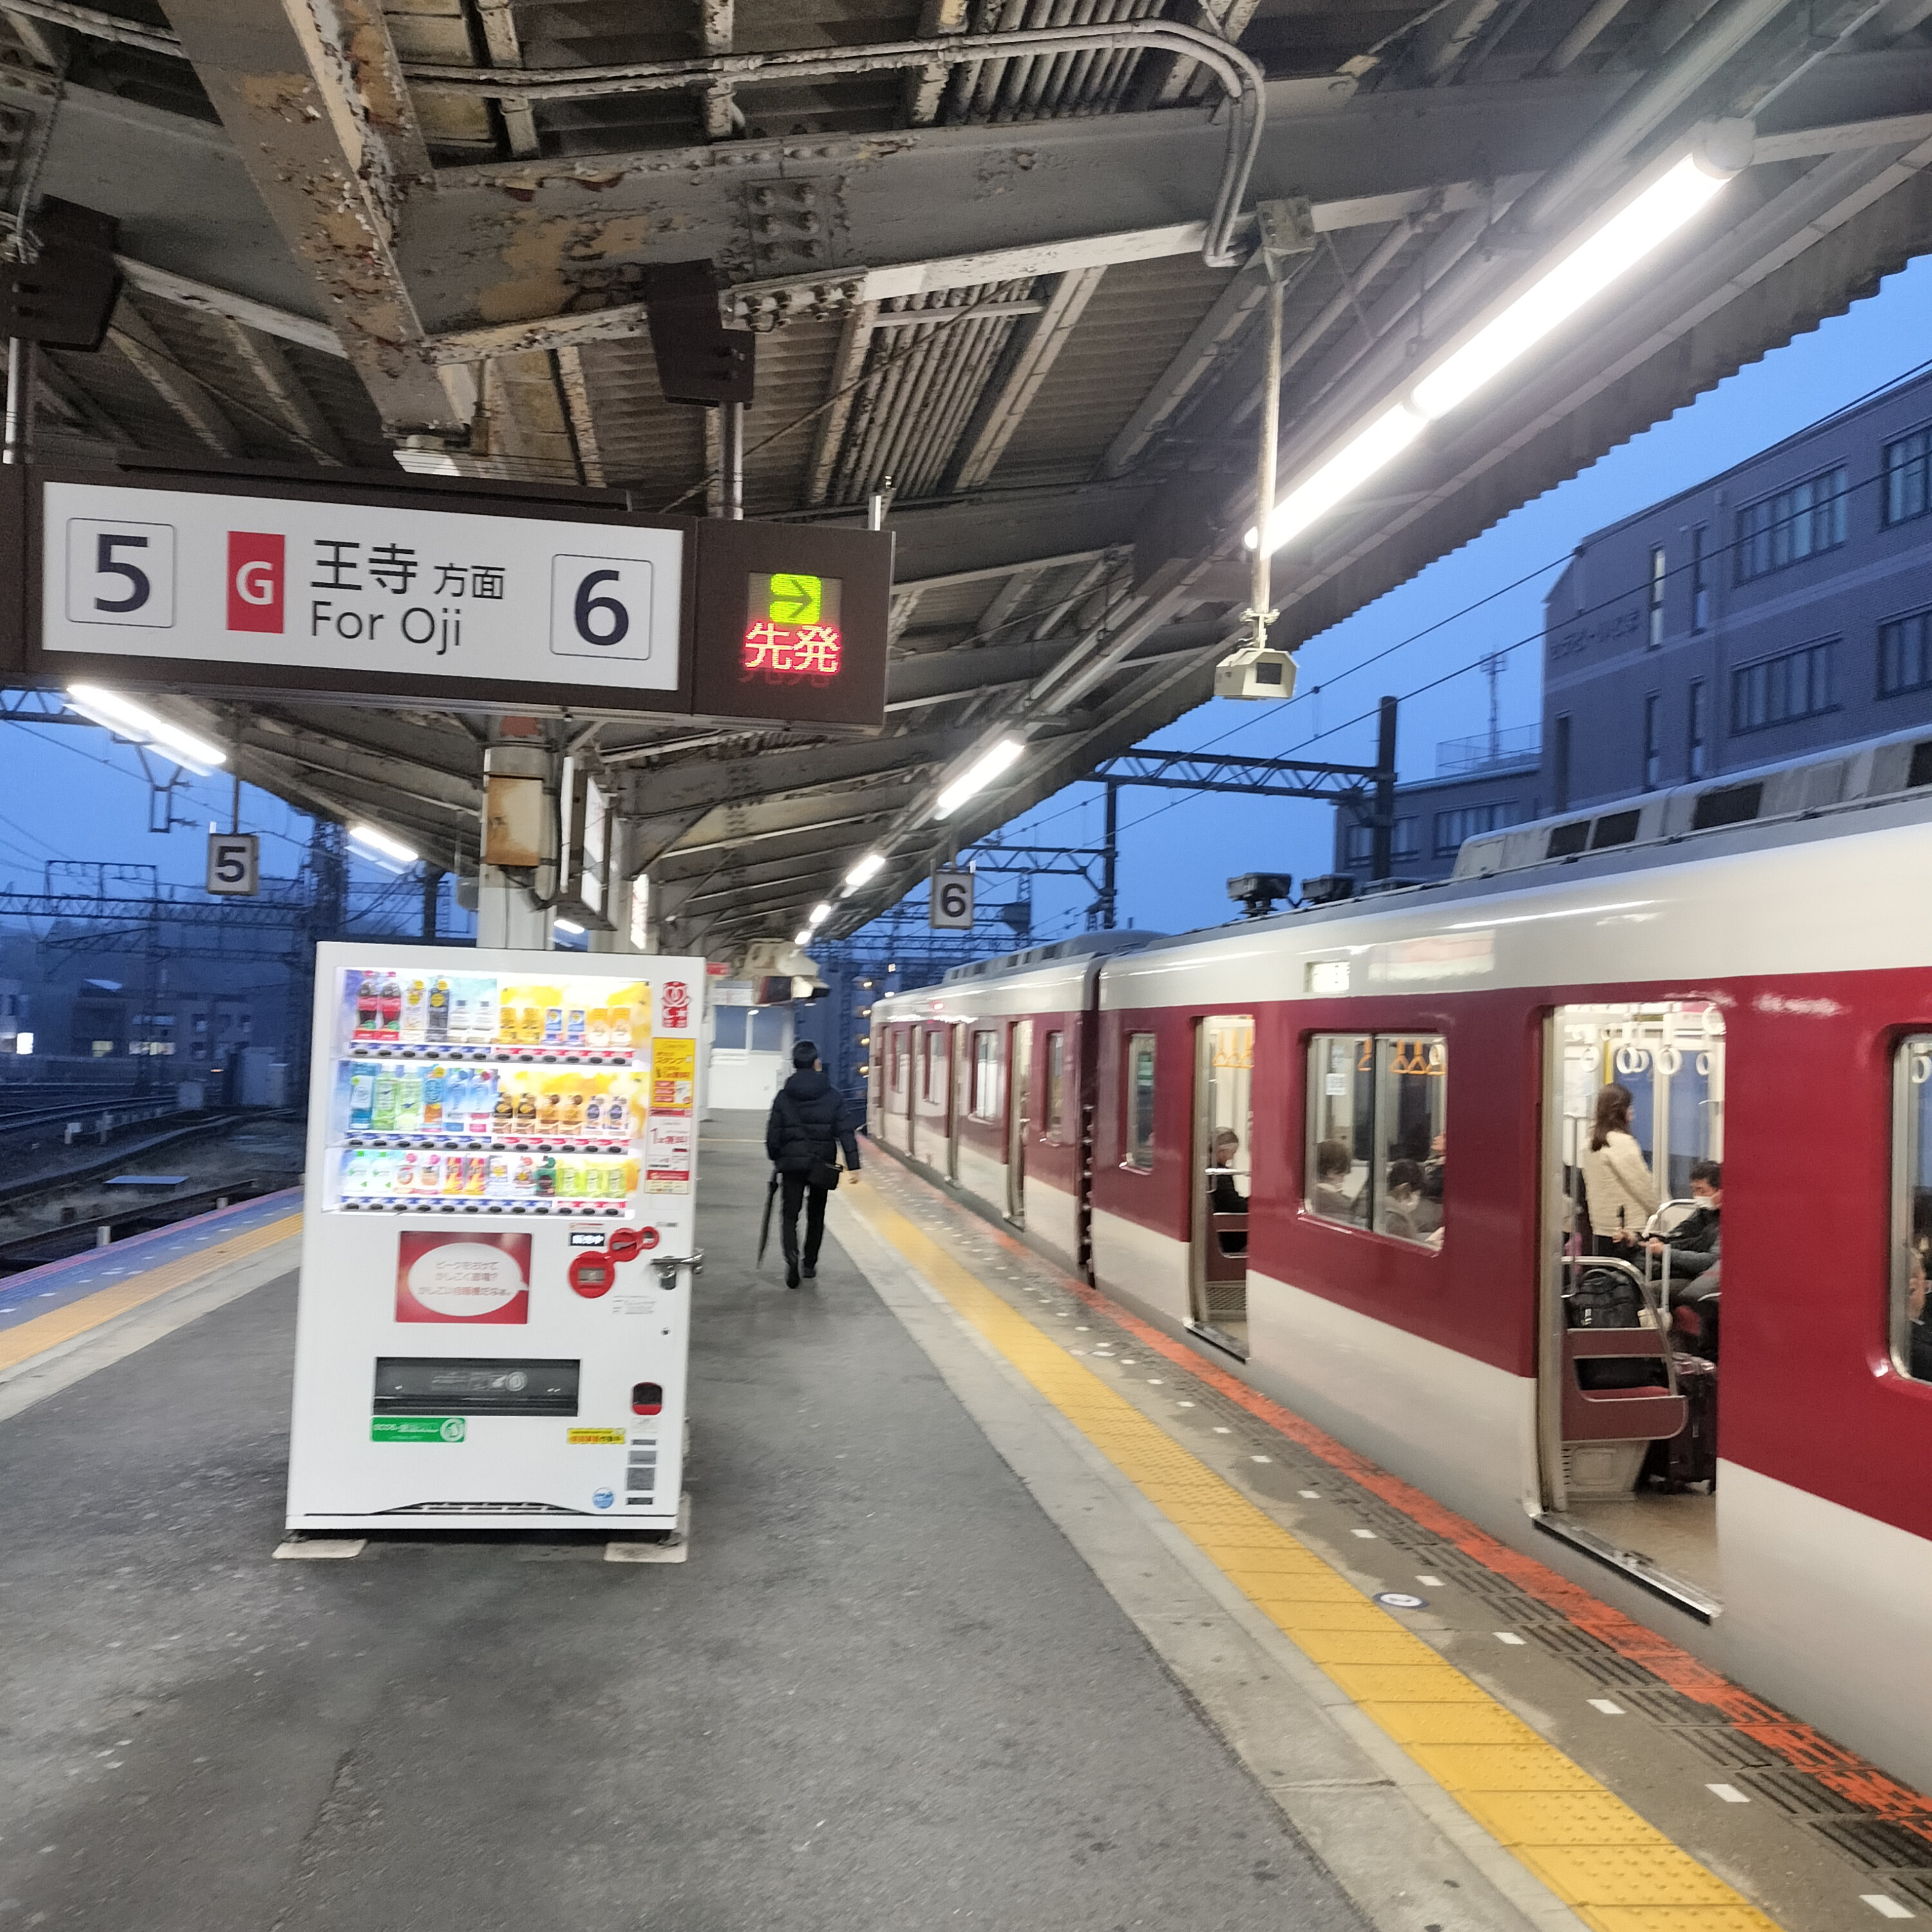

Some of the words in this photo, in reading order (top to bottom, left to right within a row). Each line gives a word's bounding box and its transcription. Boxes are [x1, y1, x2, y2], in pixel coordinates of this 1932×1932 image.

[94, 533, 151, 613] 5
[236, 561, 274, 605] G
[312, 600, 384, 640] For
[401, 607, 461, 655] Oji
[574, 569, 629, 646] 6
[744, 621, 840, 674] 先発
[215, 846, 246, 882] 5
[942, 883, 966, 918] 6
